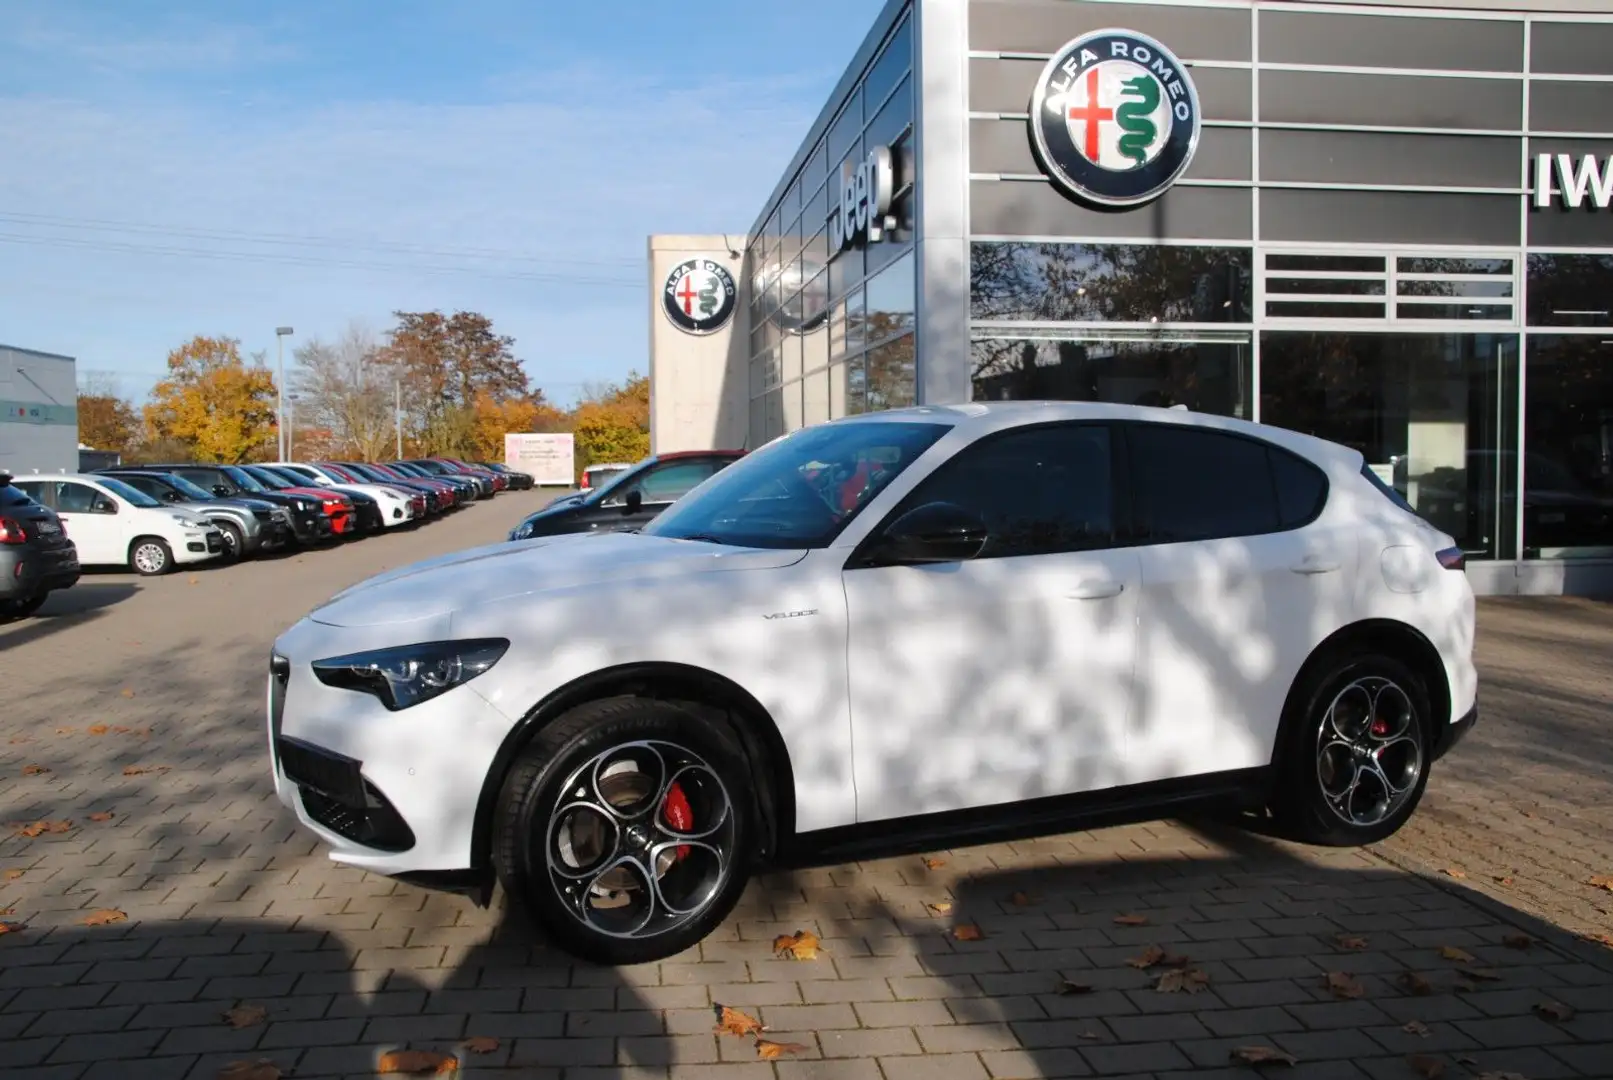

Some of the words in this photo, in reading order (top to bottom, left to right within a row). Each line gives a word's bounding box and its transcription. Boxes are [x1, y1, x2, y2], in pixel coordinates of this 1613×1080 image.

[1046, 48, 1098, 115] ALFA
[1111, 41, 1189, 121] ROMEO
[832, 145, 893, 250] Jeep
[666, 265, 690, 296] ALFA
